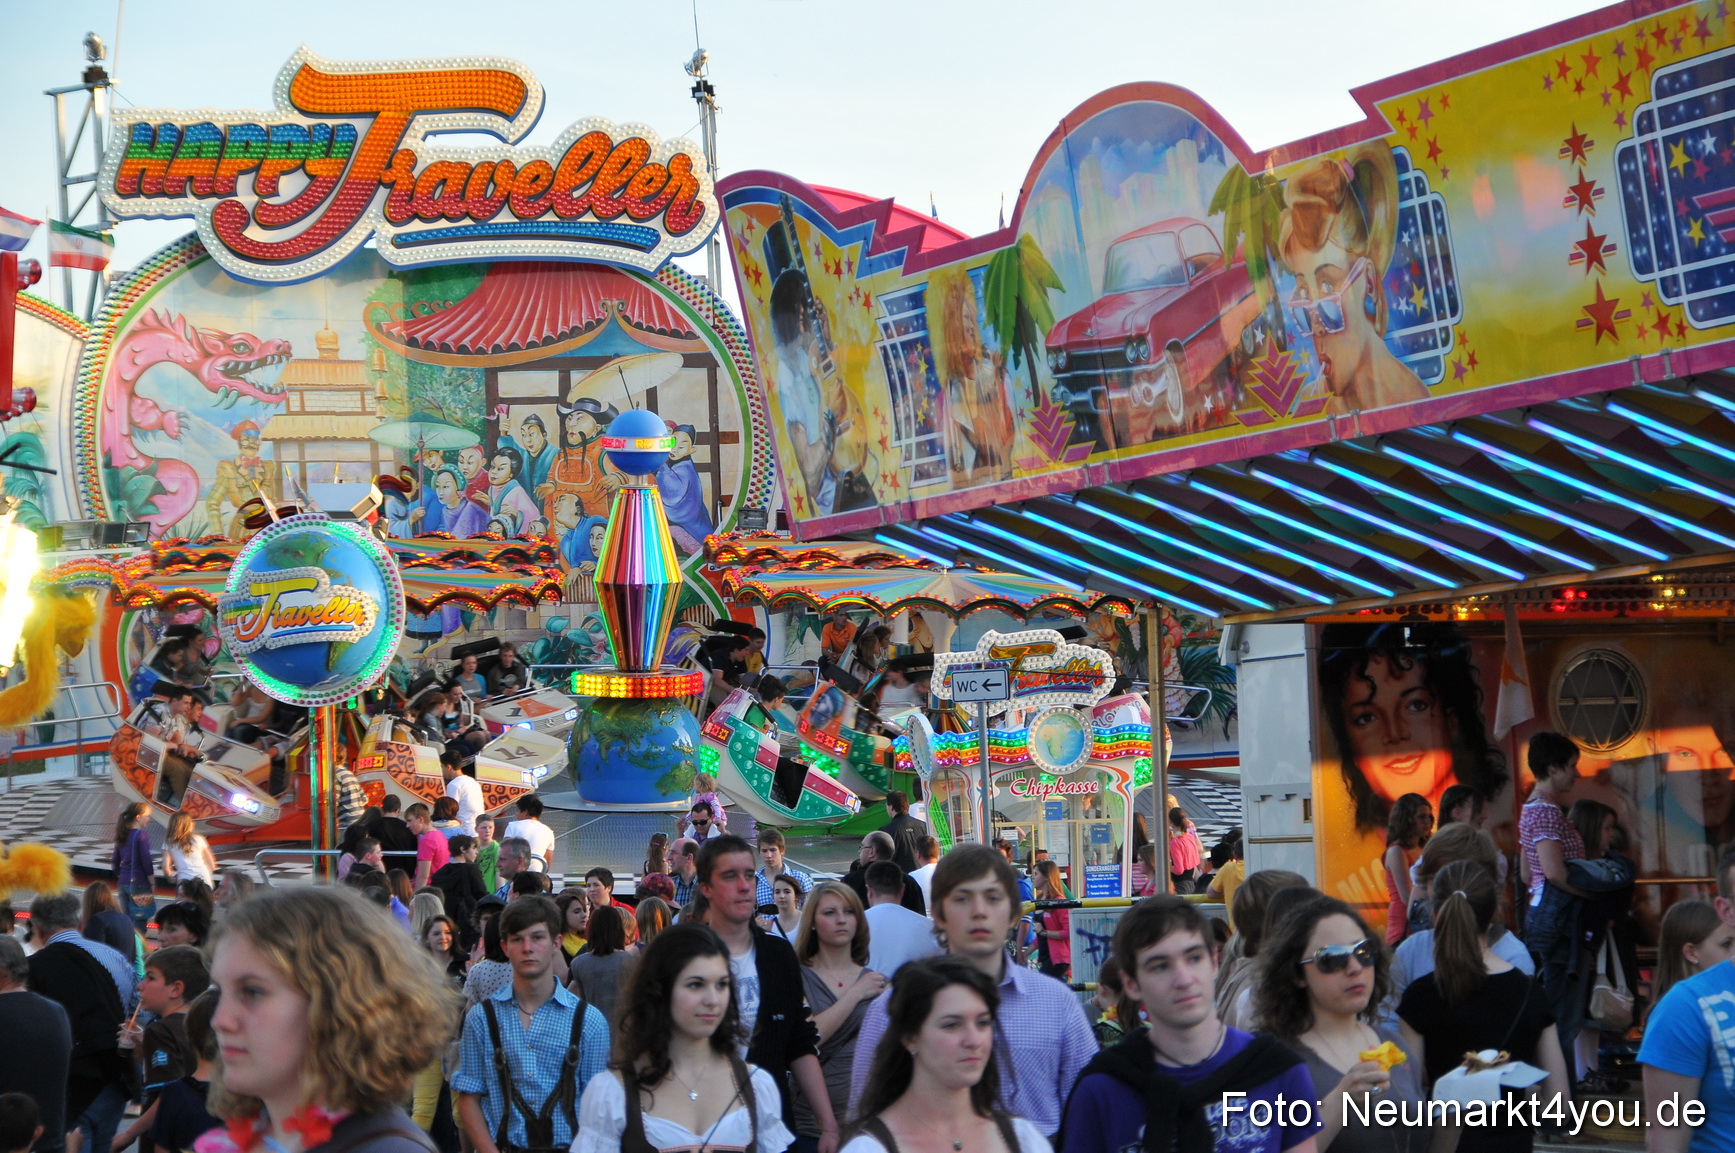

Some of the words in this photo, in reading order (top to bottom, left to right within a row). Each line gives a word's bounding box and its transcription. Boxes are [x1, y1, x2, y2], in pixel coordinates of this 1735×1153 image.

[116, 121, 358, 228] HAPPY
[211, 62, 705, 260] Traveller
[234, 577, 366, 643] Traveller
[956, 680, 978, 693] WC
[494, 745, 537, 761] 14
[1009, 777, 1099, 801] Chipkasse
